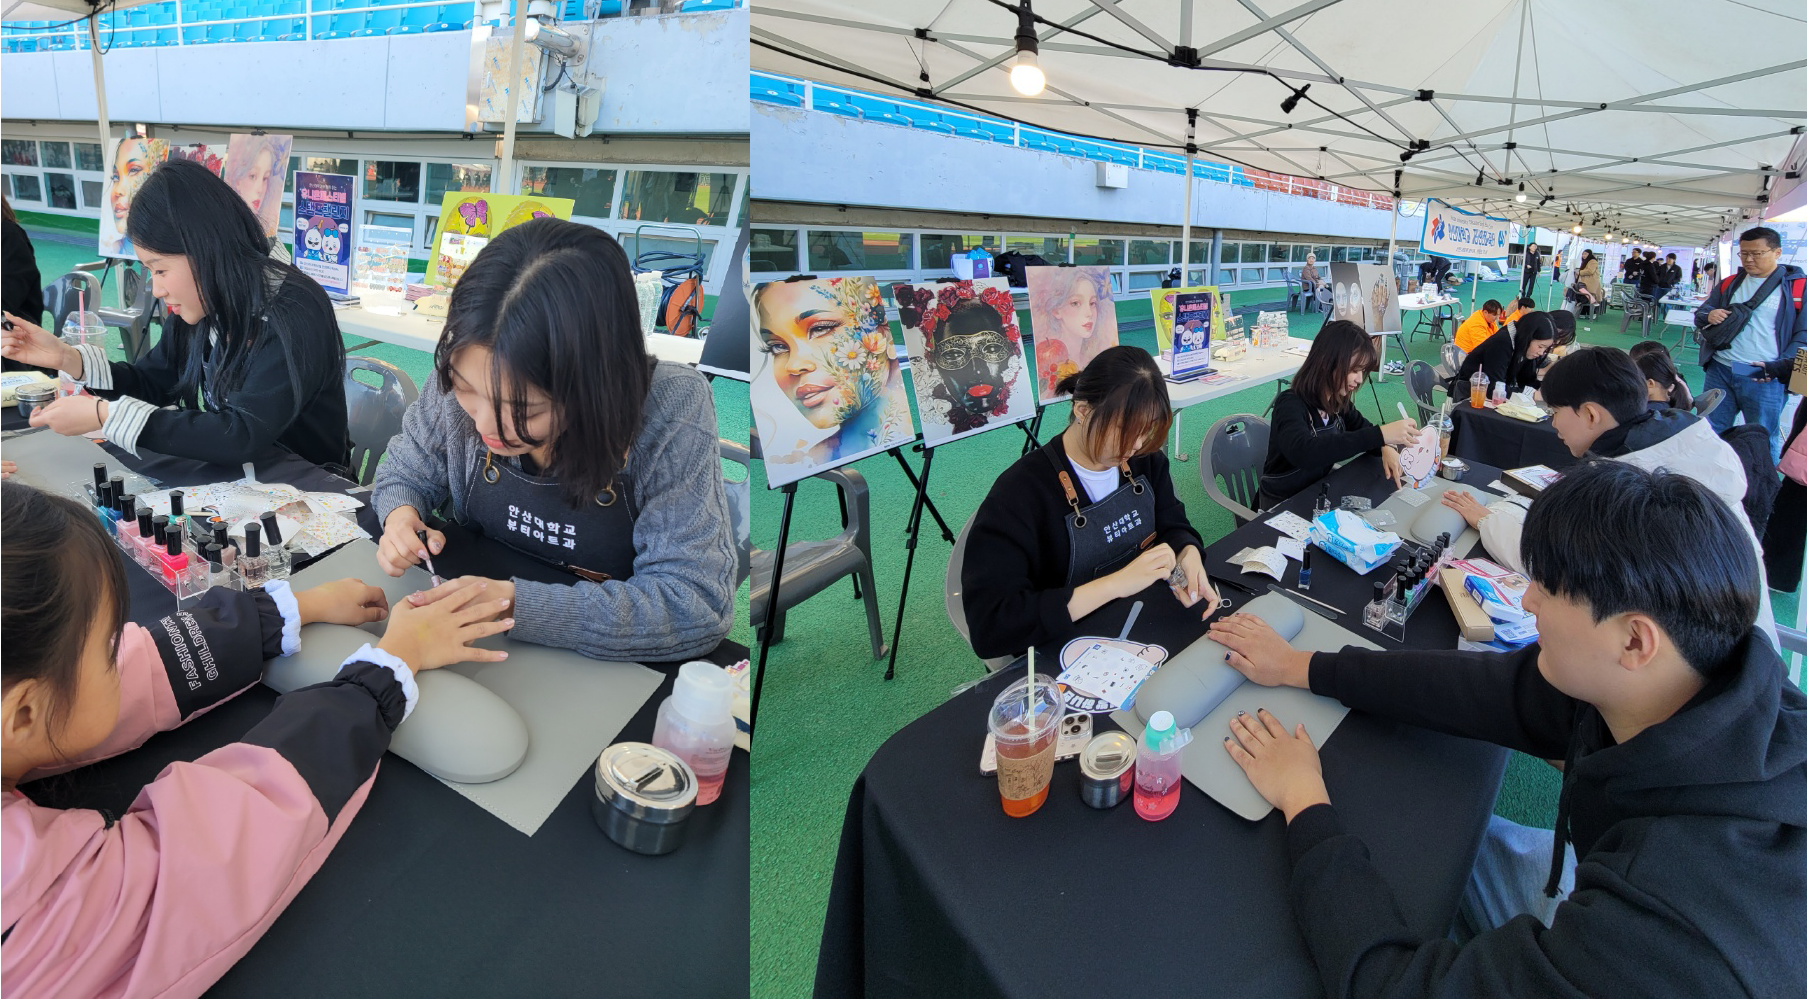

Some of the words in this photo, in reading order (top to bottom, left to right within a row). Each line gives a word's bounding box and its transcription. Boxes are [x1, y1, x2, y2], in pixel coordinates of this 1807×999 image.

[297, 200, 350, 220] 스탬프챌린지
[1793, 348, 1805, 373] GIFTS
[508, 504, 577, 536] 안산대학교
[1103, 509, 1139, 535] 안산대학교
[1106, 517, 1142, 544] 뷰티아트과
[506, 518, 577, 550] 뷰티아트과
